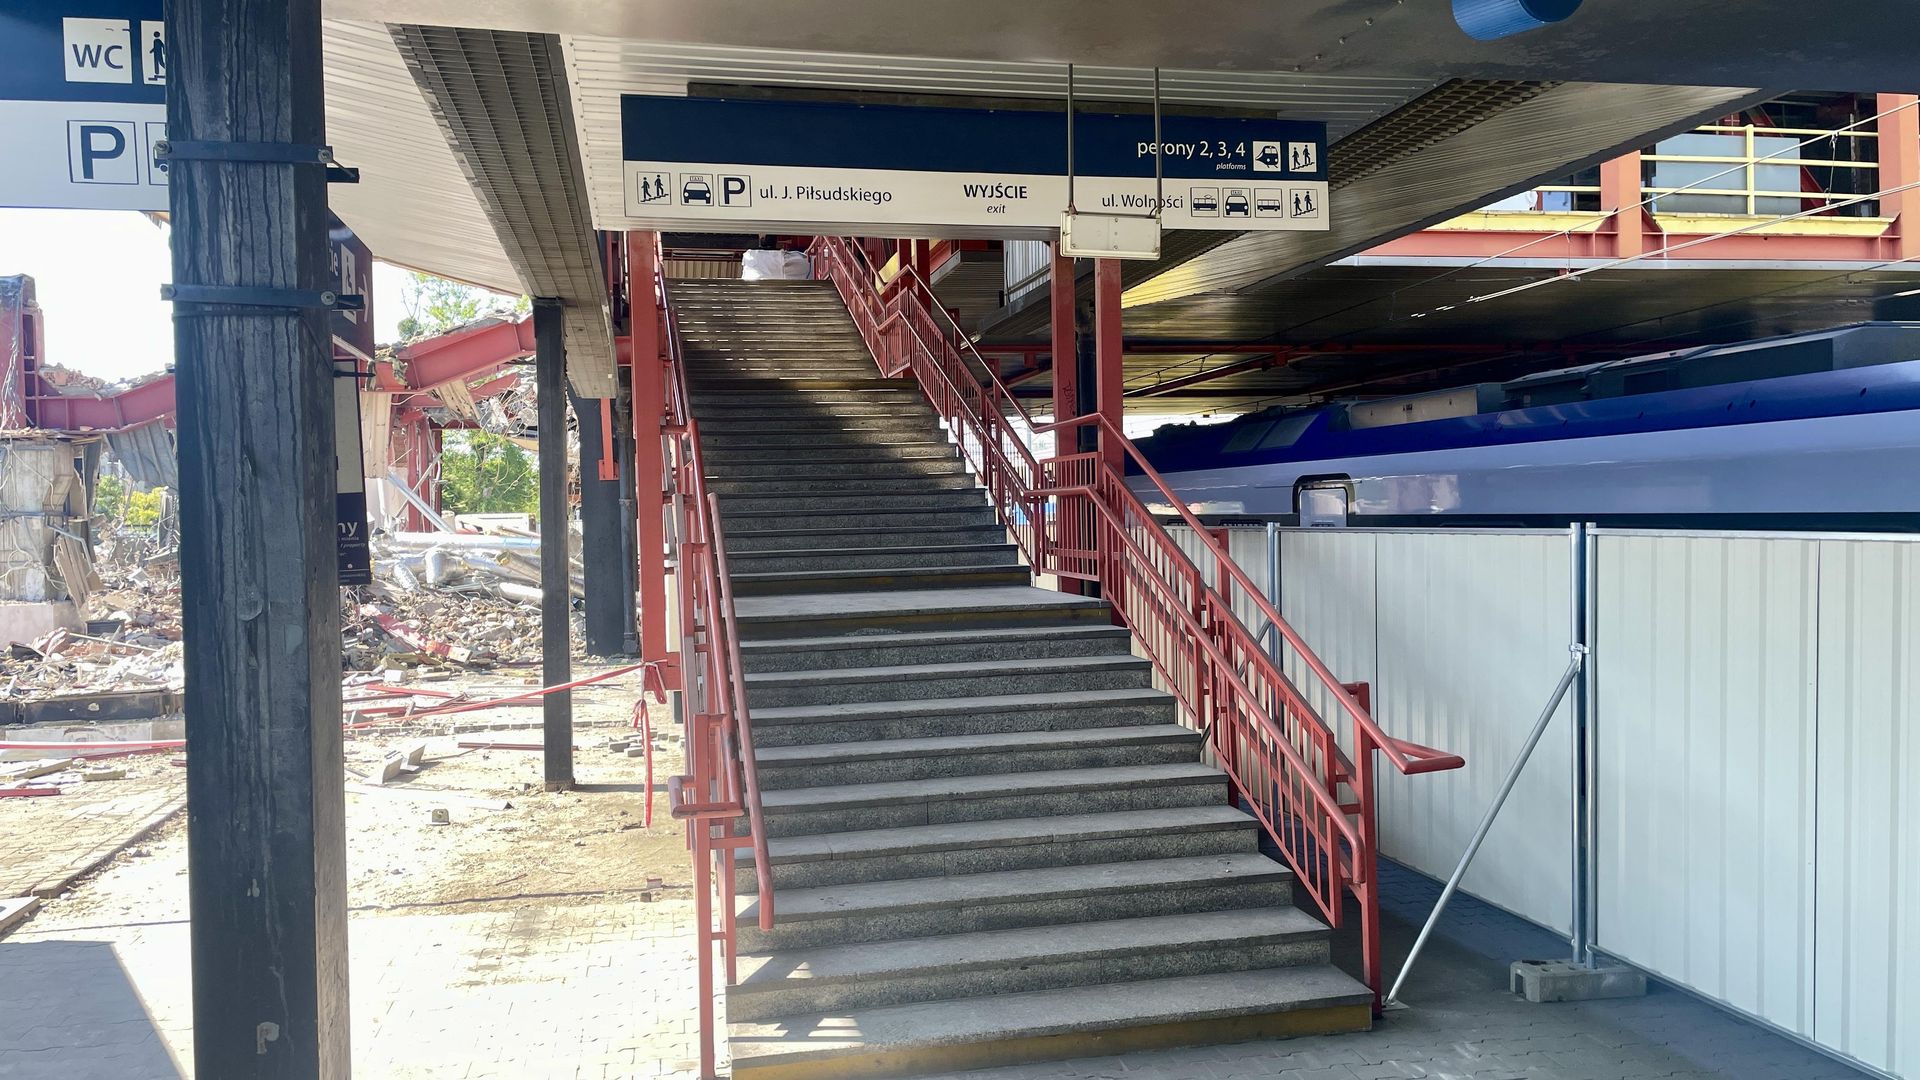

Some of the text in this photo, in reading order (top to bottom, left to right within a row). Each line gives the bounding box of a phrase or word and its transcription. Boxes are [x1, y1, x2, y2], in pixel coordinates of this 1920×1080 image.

[72, 43, 124, 70] WC
[80, 125, 126, 180] P
[1137, 141, 1246, 159] perony 2, 3, 4
[1216, 162, 1247, 171] platforms
[723, 177, 746, 205] P
[760, 185, 893, 205] ul. J. Piłsudskiego
[963, 182, 1028, 199] WYJŚCIE
[987, 204, 1006, 214] exit
[1102, 193, 1119, 208] ul.
